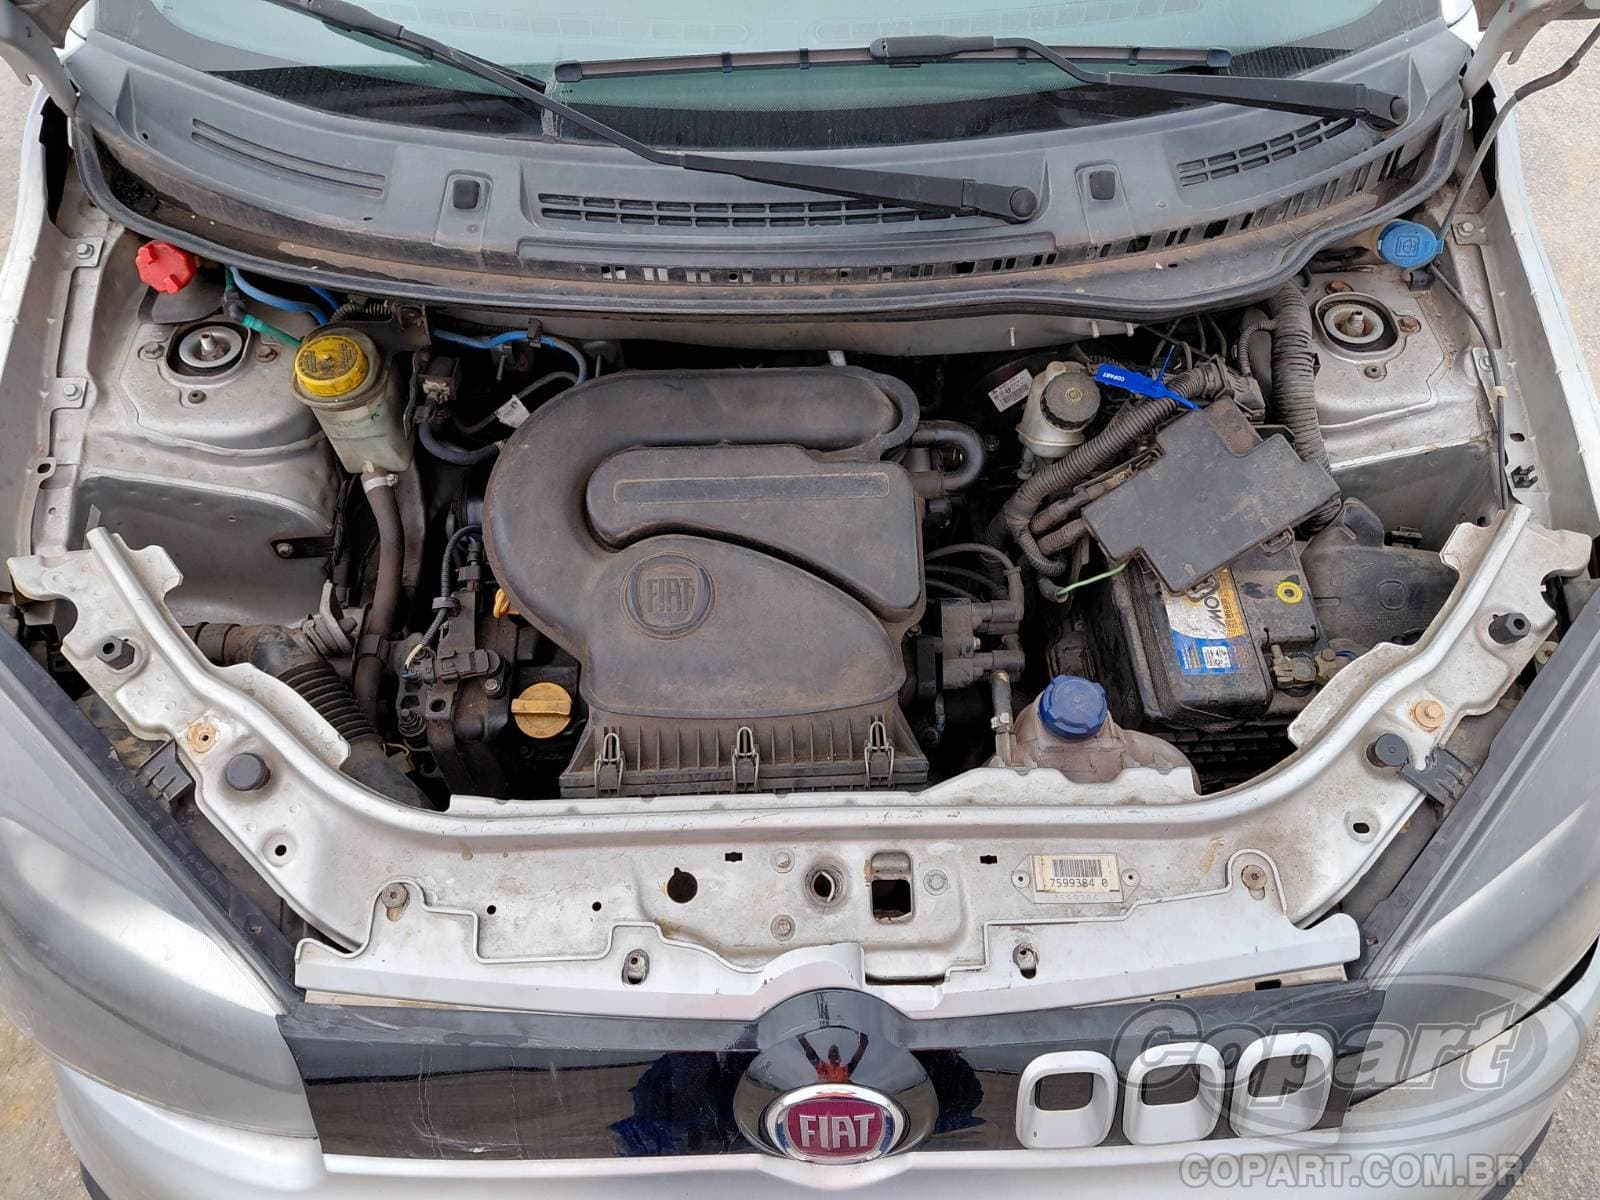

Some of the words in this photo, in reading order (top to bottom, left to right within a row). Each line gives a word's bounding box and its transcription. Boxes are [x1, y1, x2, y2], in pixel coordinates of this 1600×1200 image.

[1102, 371, 1125, 382] COPART
[646, 576, 695, 613] FIAT
[1049, 877, 1096, 888] 7599384
[799, 1113, 875, 1149] FIAT
